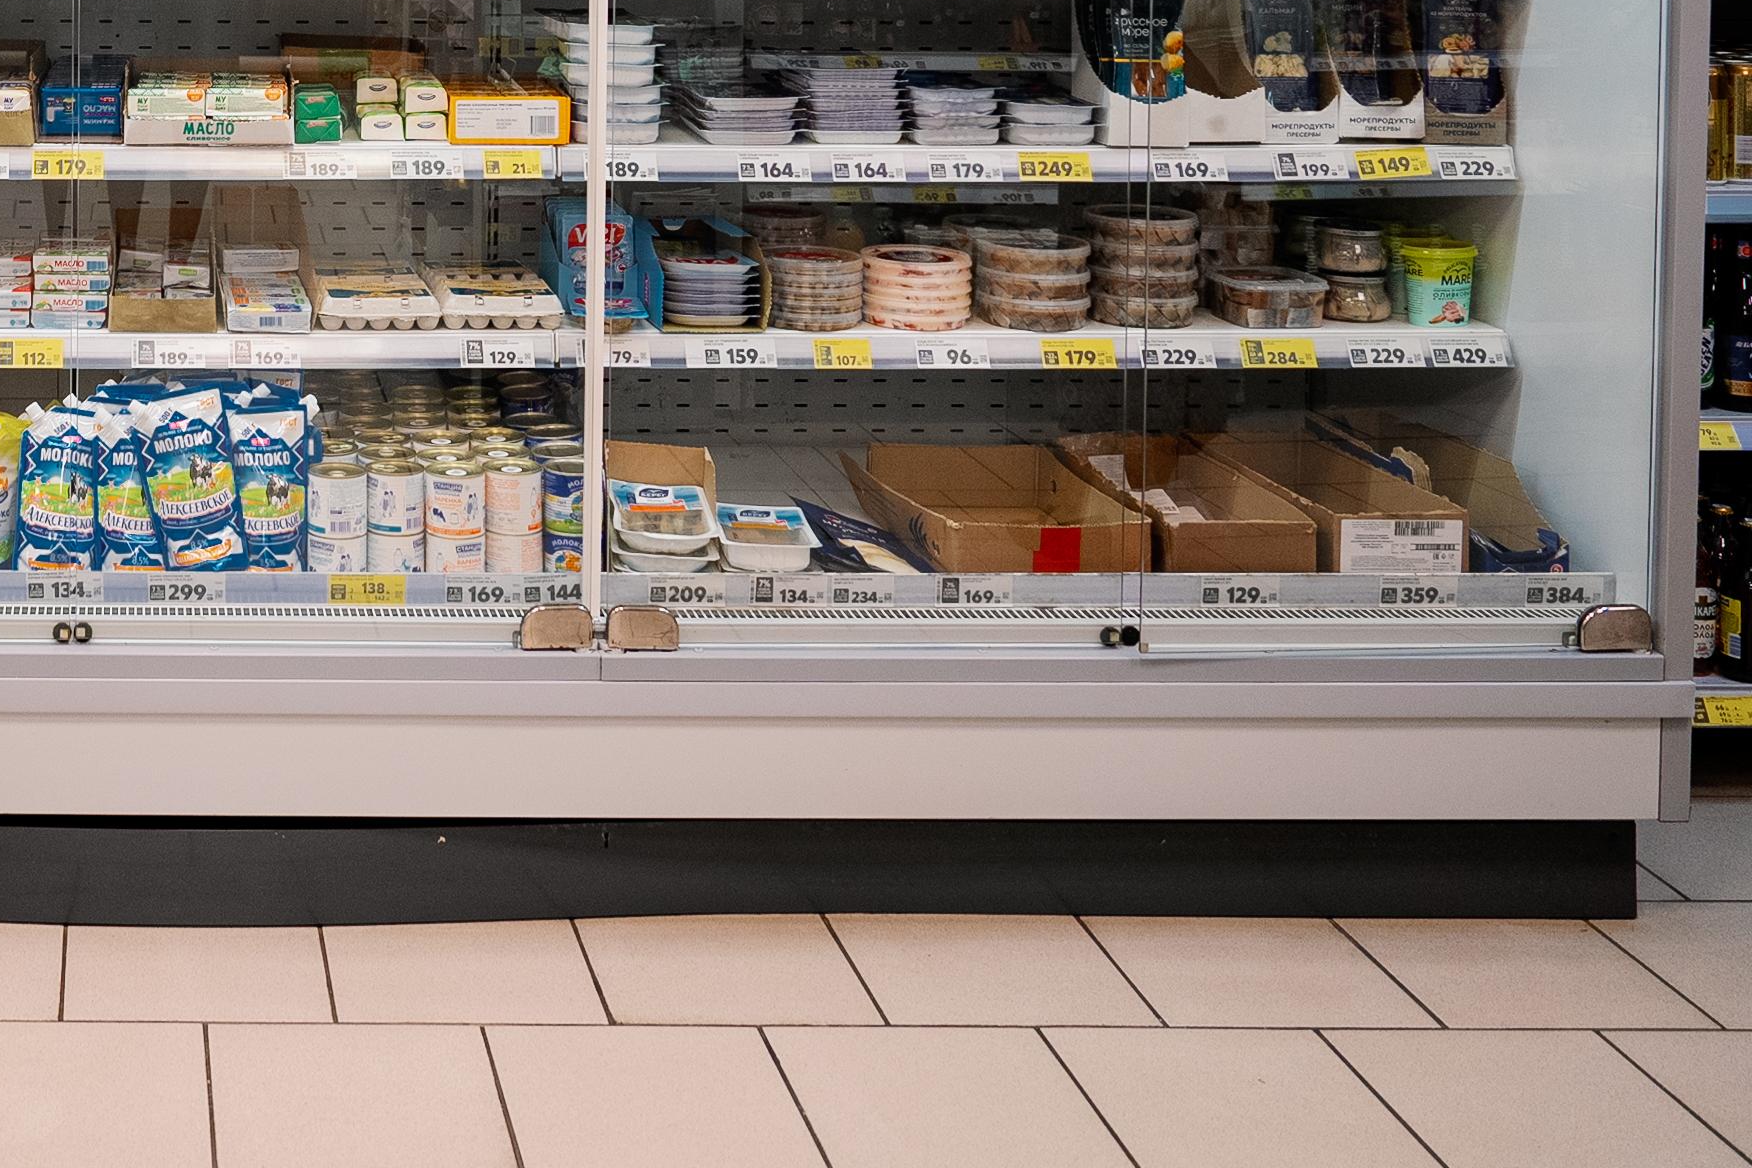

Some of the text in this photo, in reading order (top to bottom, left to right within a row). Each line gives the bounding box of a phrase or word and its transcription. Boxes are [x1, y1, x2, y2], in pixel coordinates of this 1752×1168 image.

[1271, 122, 1336, 131] МОРЕПРОДУКТЫ
[1349, 116, 1417, 126] МОРЕПРОДУКТЫ
[182, 122, 235, 136] МАСЛО
[1364, 125, 1401, 133] ПРЕСЕРВЫ
[412, 160, 446, 175] 189
[760, 163, 794, 178] 164
[854, 163, 889, 178] 164
[951, 163, 984, 178] 179
[1038, 161, 1072, 177] 249
[1174, 162, 1208, 178] 169
[1377, 157, 1411, 174] 149
[1461, 161, 1495, 177] 229
[54, 259, 85, 269] МАСЛО
[1440, 271, 1471, 286] MARE
[53, 298, 83, 307] МАСЛО
[489, 351, 517, 364] 129
[725, 349, 758, 365] 159
[947, 349, 971, 364] 96
[1065, 349, 1095, 364] 179
[1162, 349, 1196, 364] 229
[1372, 348, 1406, 363] 229
[1450, 348, 1485, 364] 429
[155, 430, 213, 454] МОЛОКО
[233, 450, 291, 467] МОЛОКО
[156, 490, 232, 516] АЛЕКСЕЕВСКОЕ
[168, 583, 207, 601] 299
[468, 585, 504, 602] 169
[547, 584, 582, 600] 144
[667, 587, 707, 603] 209
[779, 589, 808, 604] 134
[964, 590, 993, 604] 169
[1545, 587, 1584, 604] 384
